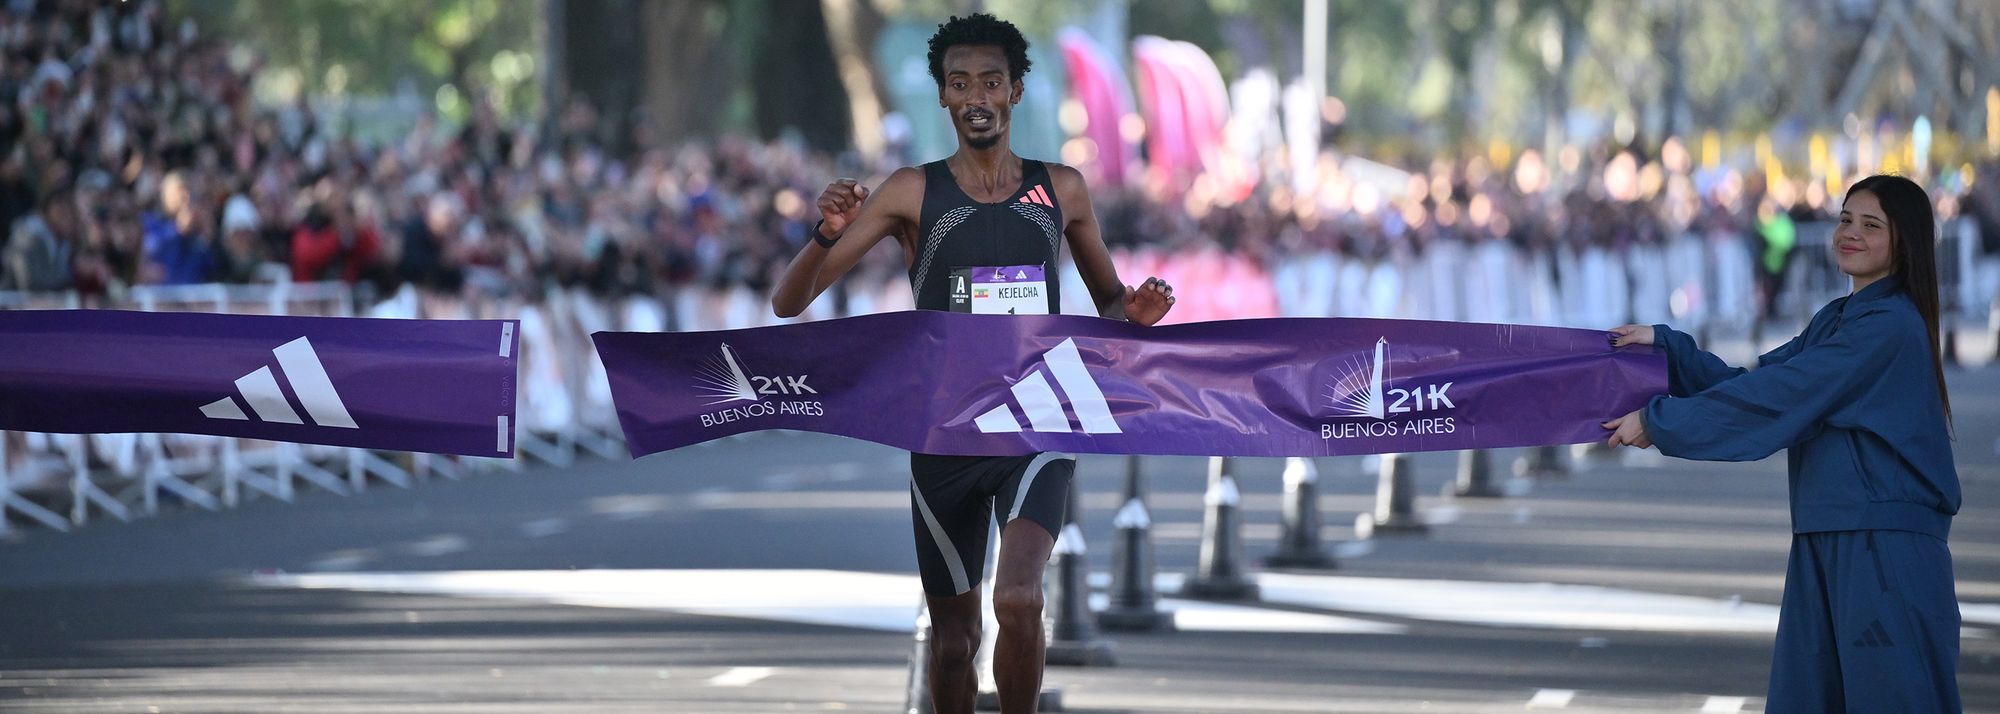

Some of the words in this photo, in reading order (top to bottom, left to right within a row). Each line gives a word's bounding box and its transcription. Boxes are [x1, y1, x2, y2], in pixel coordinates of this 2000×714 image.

[956, 276, 965, 293] A
[998, 287, 1039, 299] KEJELCHA
[751, 374, 818, 395] 21K
[1386, 382, 1456, 413] 21K
[700, 401, 775, 428] BUENOS
[780, 401, 824, 417] AIRES
[1321, 421, 1398, 439] BUENOS
[1403, 417, 1456, 435] AIRES
